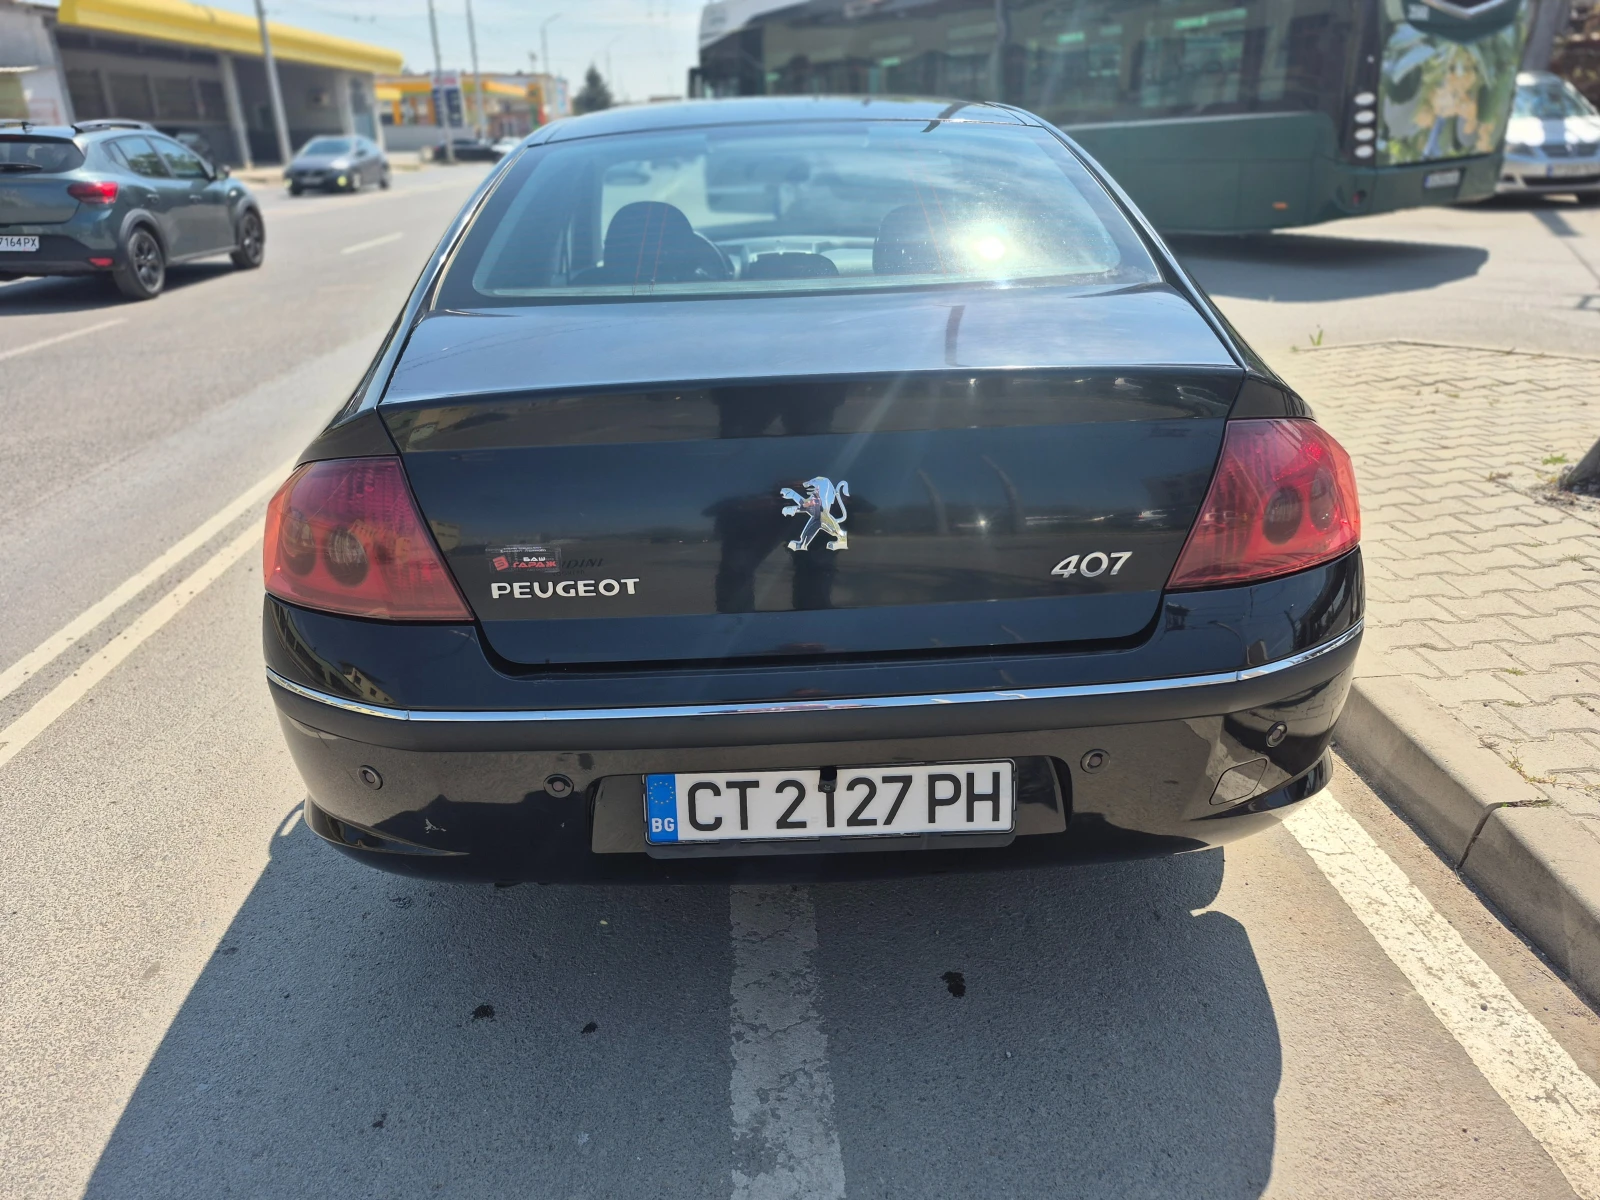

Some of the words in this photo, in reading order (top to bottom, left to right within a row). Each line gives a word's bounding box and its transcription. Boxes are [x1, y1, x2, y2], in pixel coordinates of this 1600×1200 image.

[23, 237, 37, 248] PX
[1050, 551, 1134, 579] 407
[491, 578, 640, 599] PEUGEOT
[687, 780, 760, 832] CT
[775, 775, 913, 829] 2127
[927, 771, 1001, 824] PH
[651, 817, 675, 833] BG
